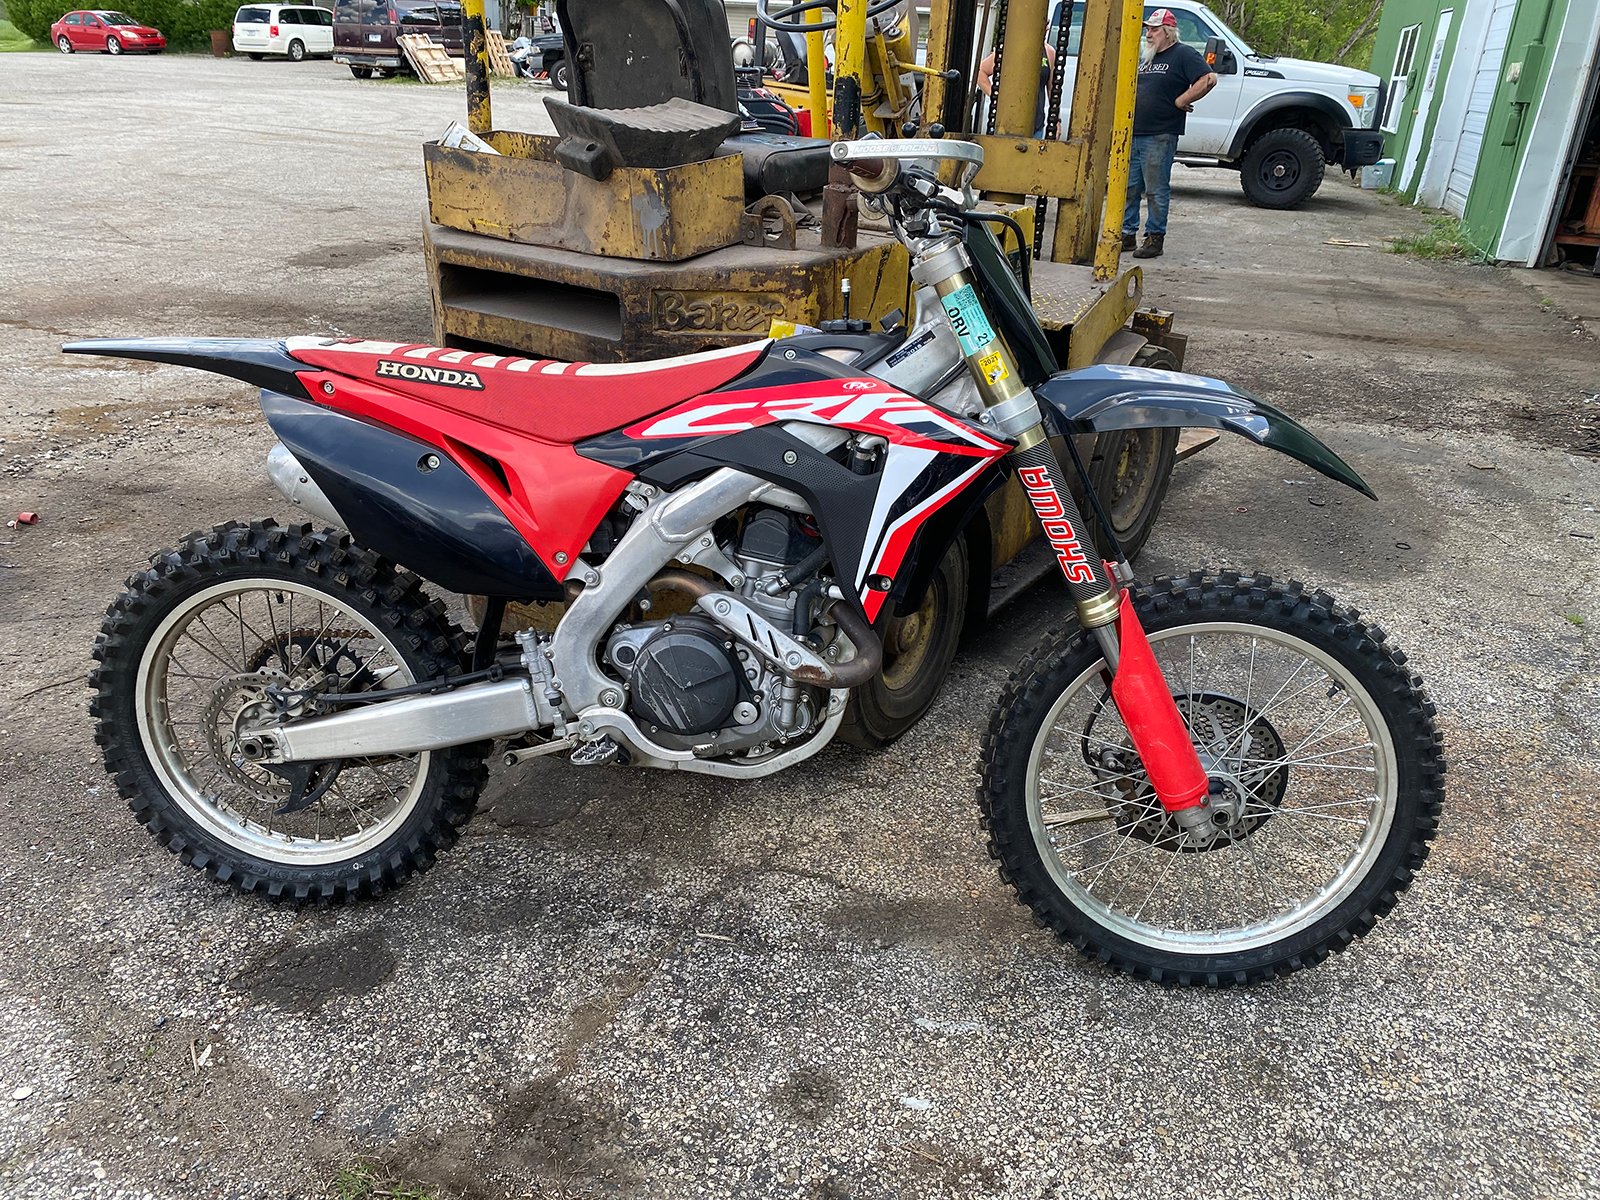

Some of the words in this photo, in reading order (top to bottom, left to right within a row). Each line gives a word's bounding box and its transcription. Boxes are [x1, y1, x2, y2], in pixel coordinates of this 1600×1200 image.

[898, 143, 936, 152] RACING
[654, 291, 785, 331] Baker
[947, 307, 971, 337] ORV
[977, 332, 990, 347] 21
[377, 360, 483, 388] HONDA
[983, 355, 999, 366] 2021
[1018, 465, 1097, 583] SHOWA
